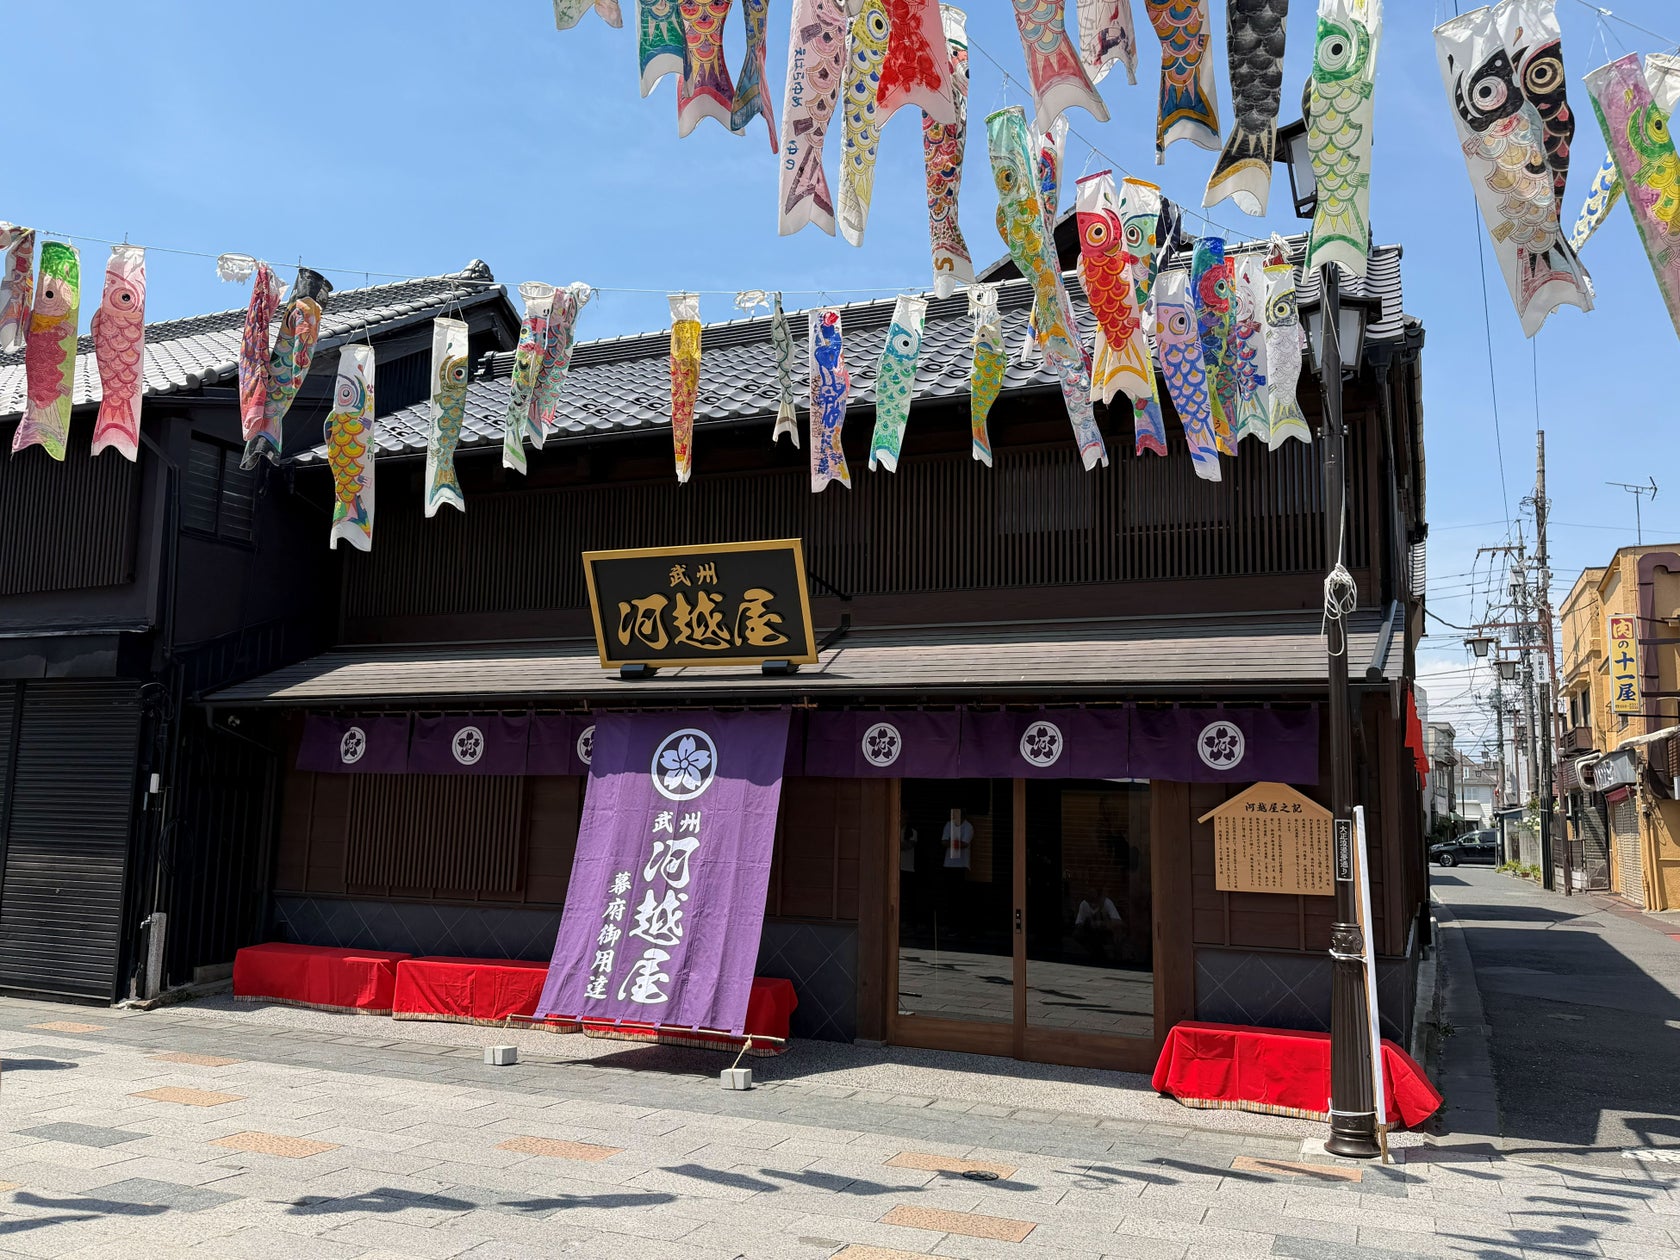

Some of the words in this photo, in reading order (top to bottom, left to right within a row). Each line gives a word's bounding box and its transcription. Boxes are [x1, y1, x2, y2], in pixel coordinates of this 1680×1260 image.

[668, 561, 718, 587] 武州
[617, 588, 790, 650] 河越屋
[1612, 618, 1637, 702] 肉の十一屋
[651, 811, 702, 834] 武州
[583, 871, 632, 1000] 幕府御用達
[617, 836, 701, 1004] 河越屋
